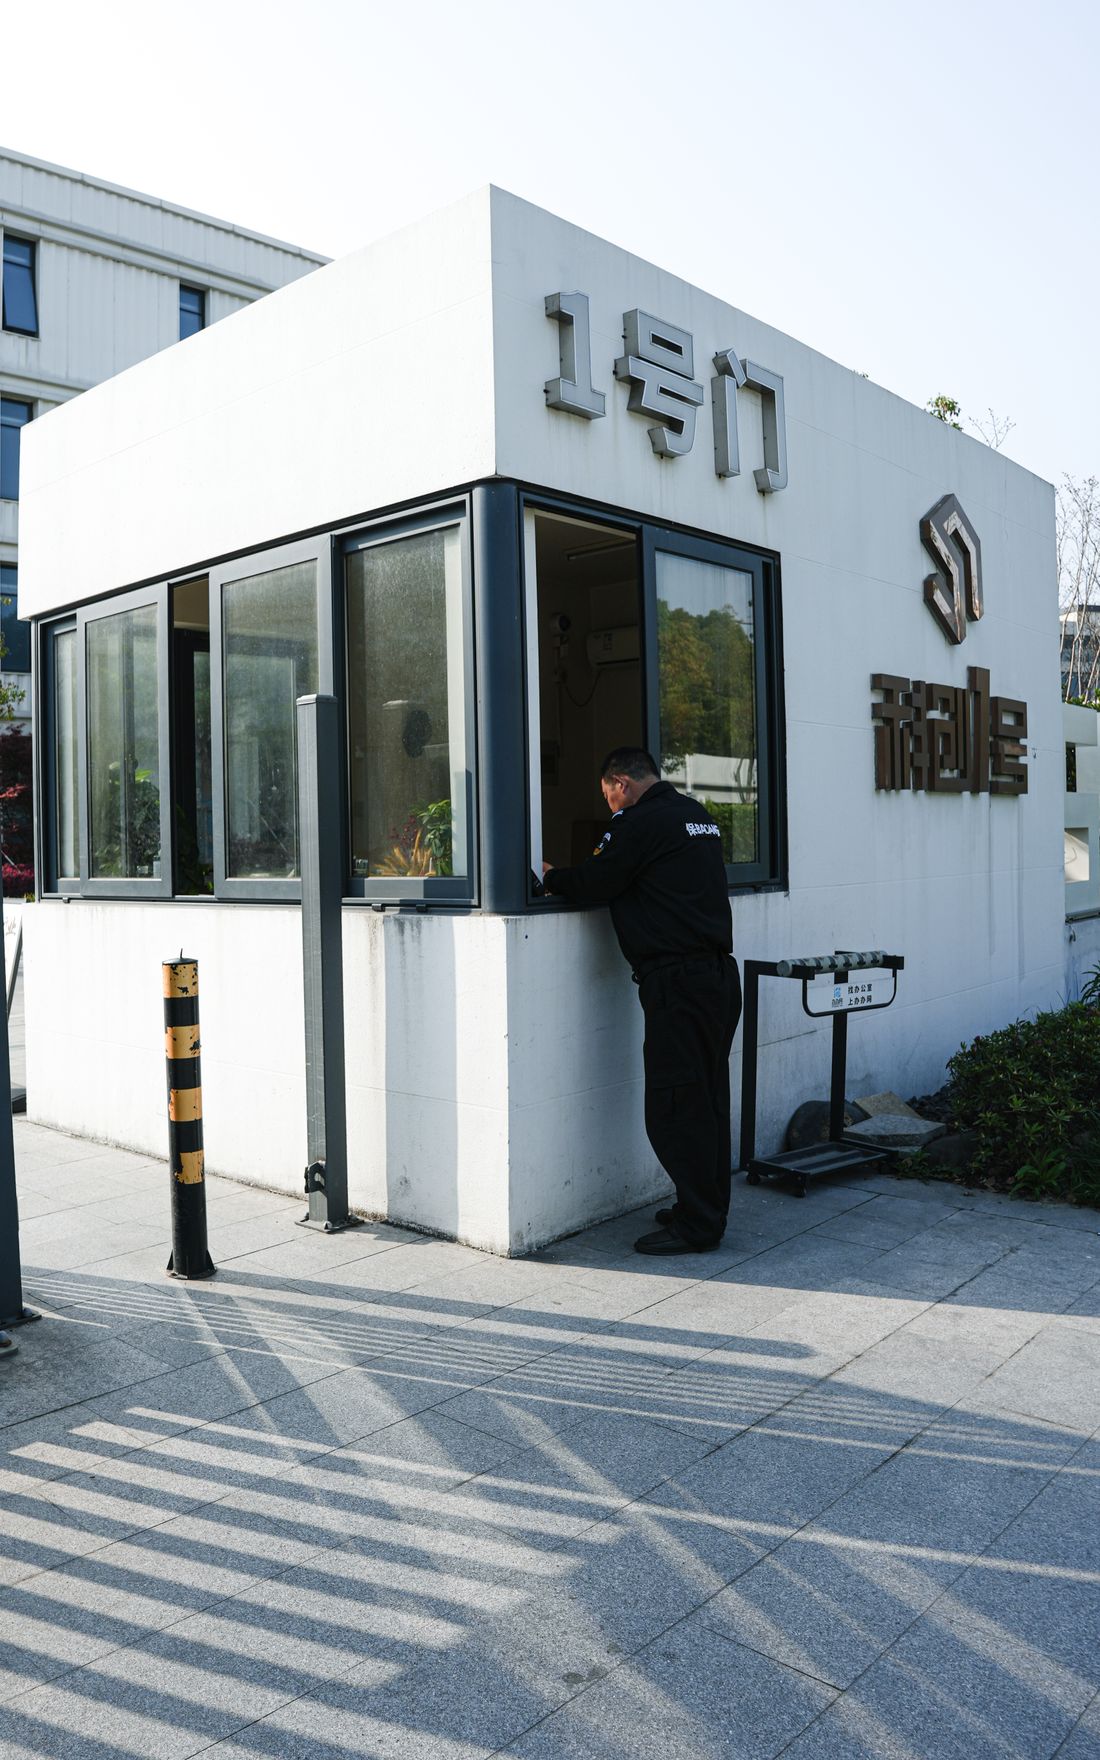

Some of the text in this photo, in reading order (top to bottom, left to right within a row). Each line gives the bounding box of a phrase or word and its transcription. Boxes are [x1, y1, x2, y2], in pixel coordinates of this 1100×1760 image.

[544, 290, 789, 494] 1号门
[848, 983, 872, 994] 找办公室
[848, 995, 872, 1006] 上办办网
